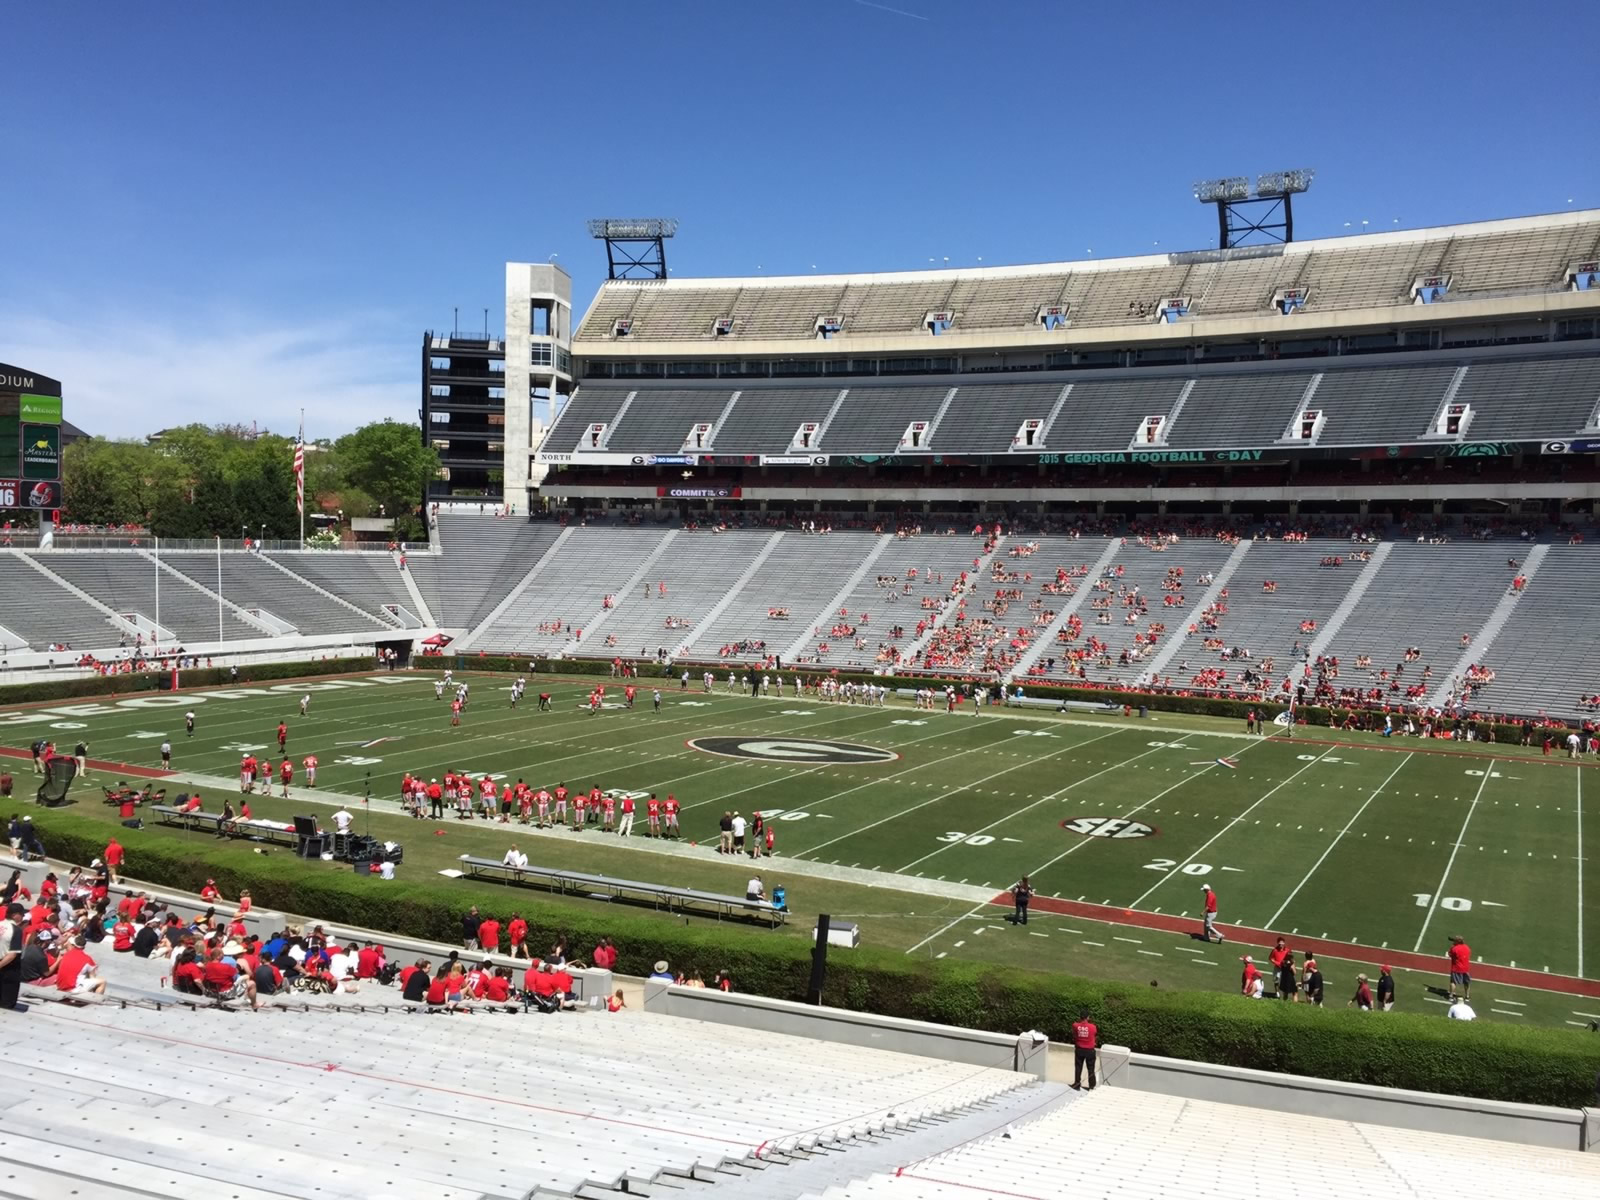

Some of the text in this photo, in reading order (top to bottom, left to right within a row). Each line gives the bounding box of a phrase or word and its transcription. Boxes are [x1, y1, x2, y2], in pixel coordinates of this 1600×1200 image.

[541, 453, 572, 461] NORTH
[1038, 453, 1059, 464] 2015
[1063, 452, 1125, 463] GEORGIA
[1131, 450, 1206, 463] FOOTBALL
[670, 489, 706, 497] COMMIT
[1064, 817, 1152, 839] SEC
[935, 831, 996, 846] 30
[1142, 858, 1214, 876] 20
[1412, 893, 1473, 912] 10
